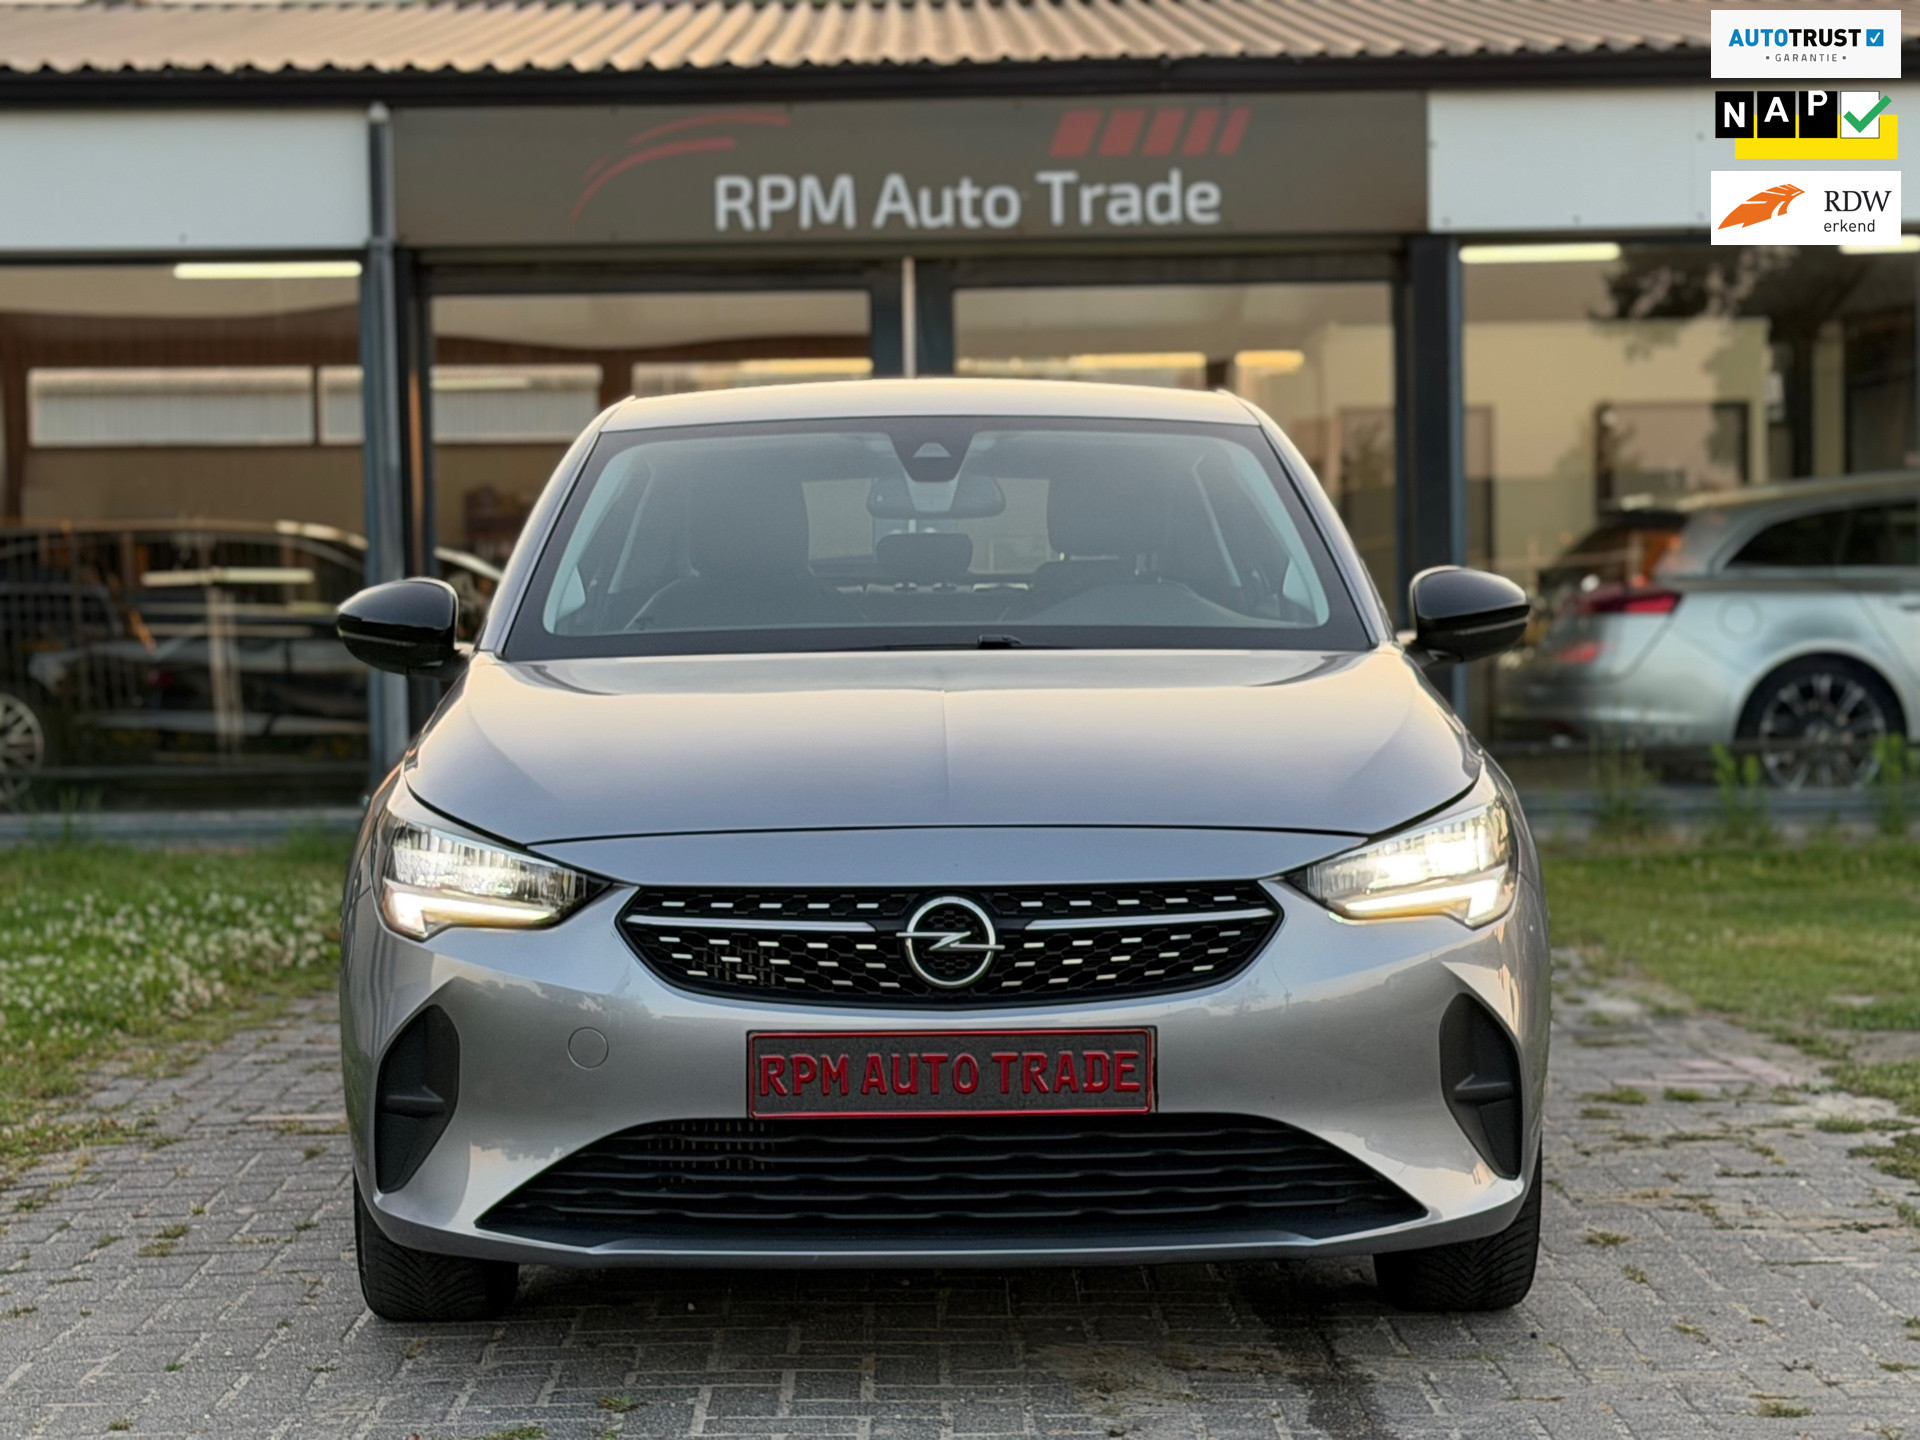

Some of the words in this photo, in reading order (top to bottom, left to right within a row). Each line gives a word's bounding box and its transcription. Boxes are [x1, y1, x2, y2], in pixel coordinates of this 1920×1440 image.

[714, 174, 856, 231] RPM
[871, 173, 1022, 228] Auto
[1035, 168, 1221, 226] Trade
[759, 1053, 849, 1096] RPM
[861, 1052, 980, 1095] AUTO
[990, 1050, 1141, 1094] TRADE
